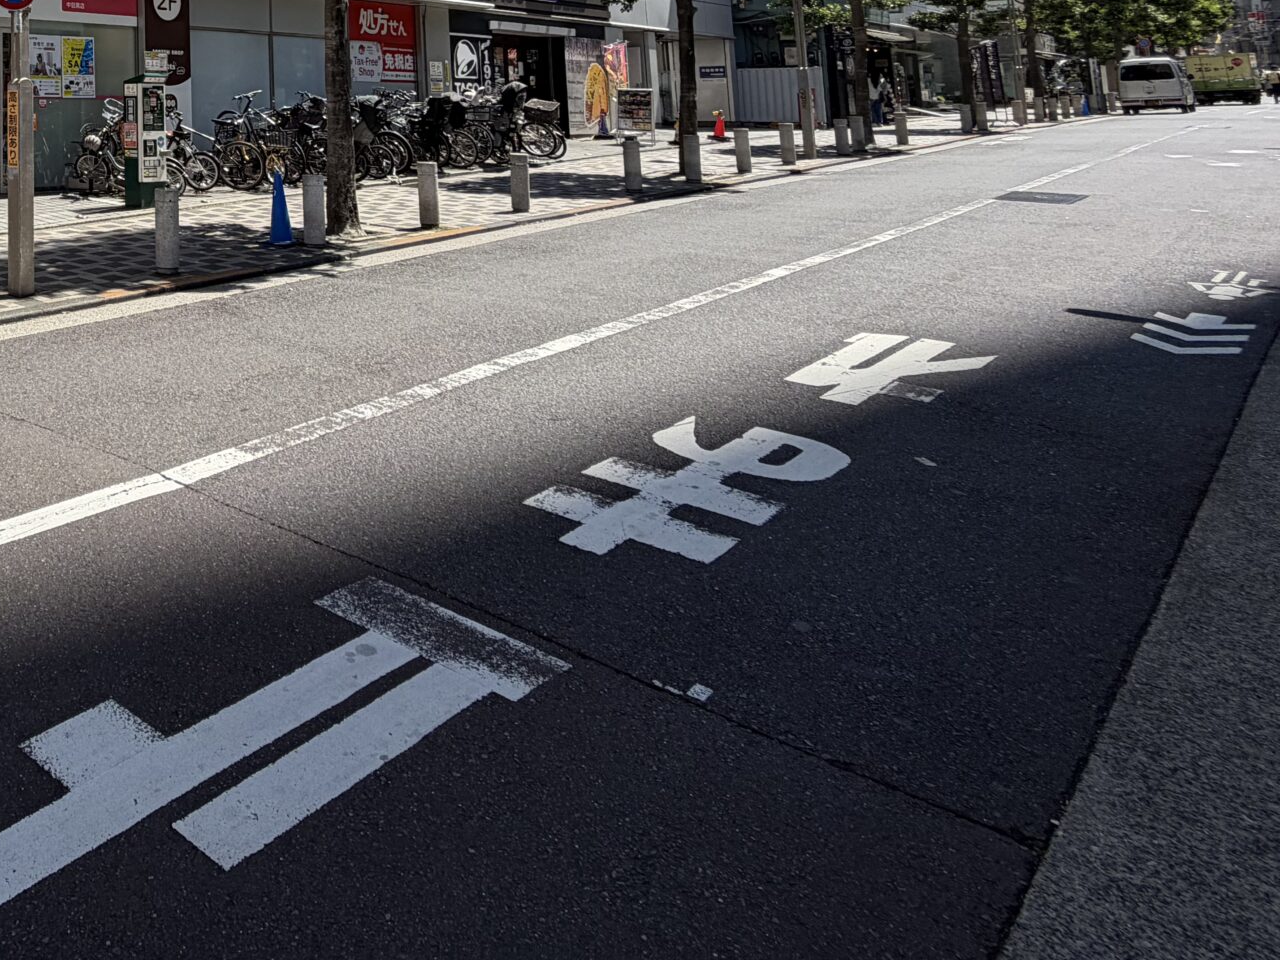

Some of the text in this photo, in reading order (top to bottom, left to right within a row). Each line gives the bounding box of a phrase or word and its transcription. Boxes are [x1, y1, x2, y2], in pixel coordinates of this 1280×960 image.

[359, 7, 408, 37] 処方せん
[384, 52, 414, 71] 免税店
[358, 67, 375, 77] Shop
